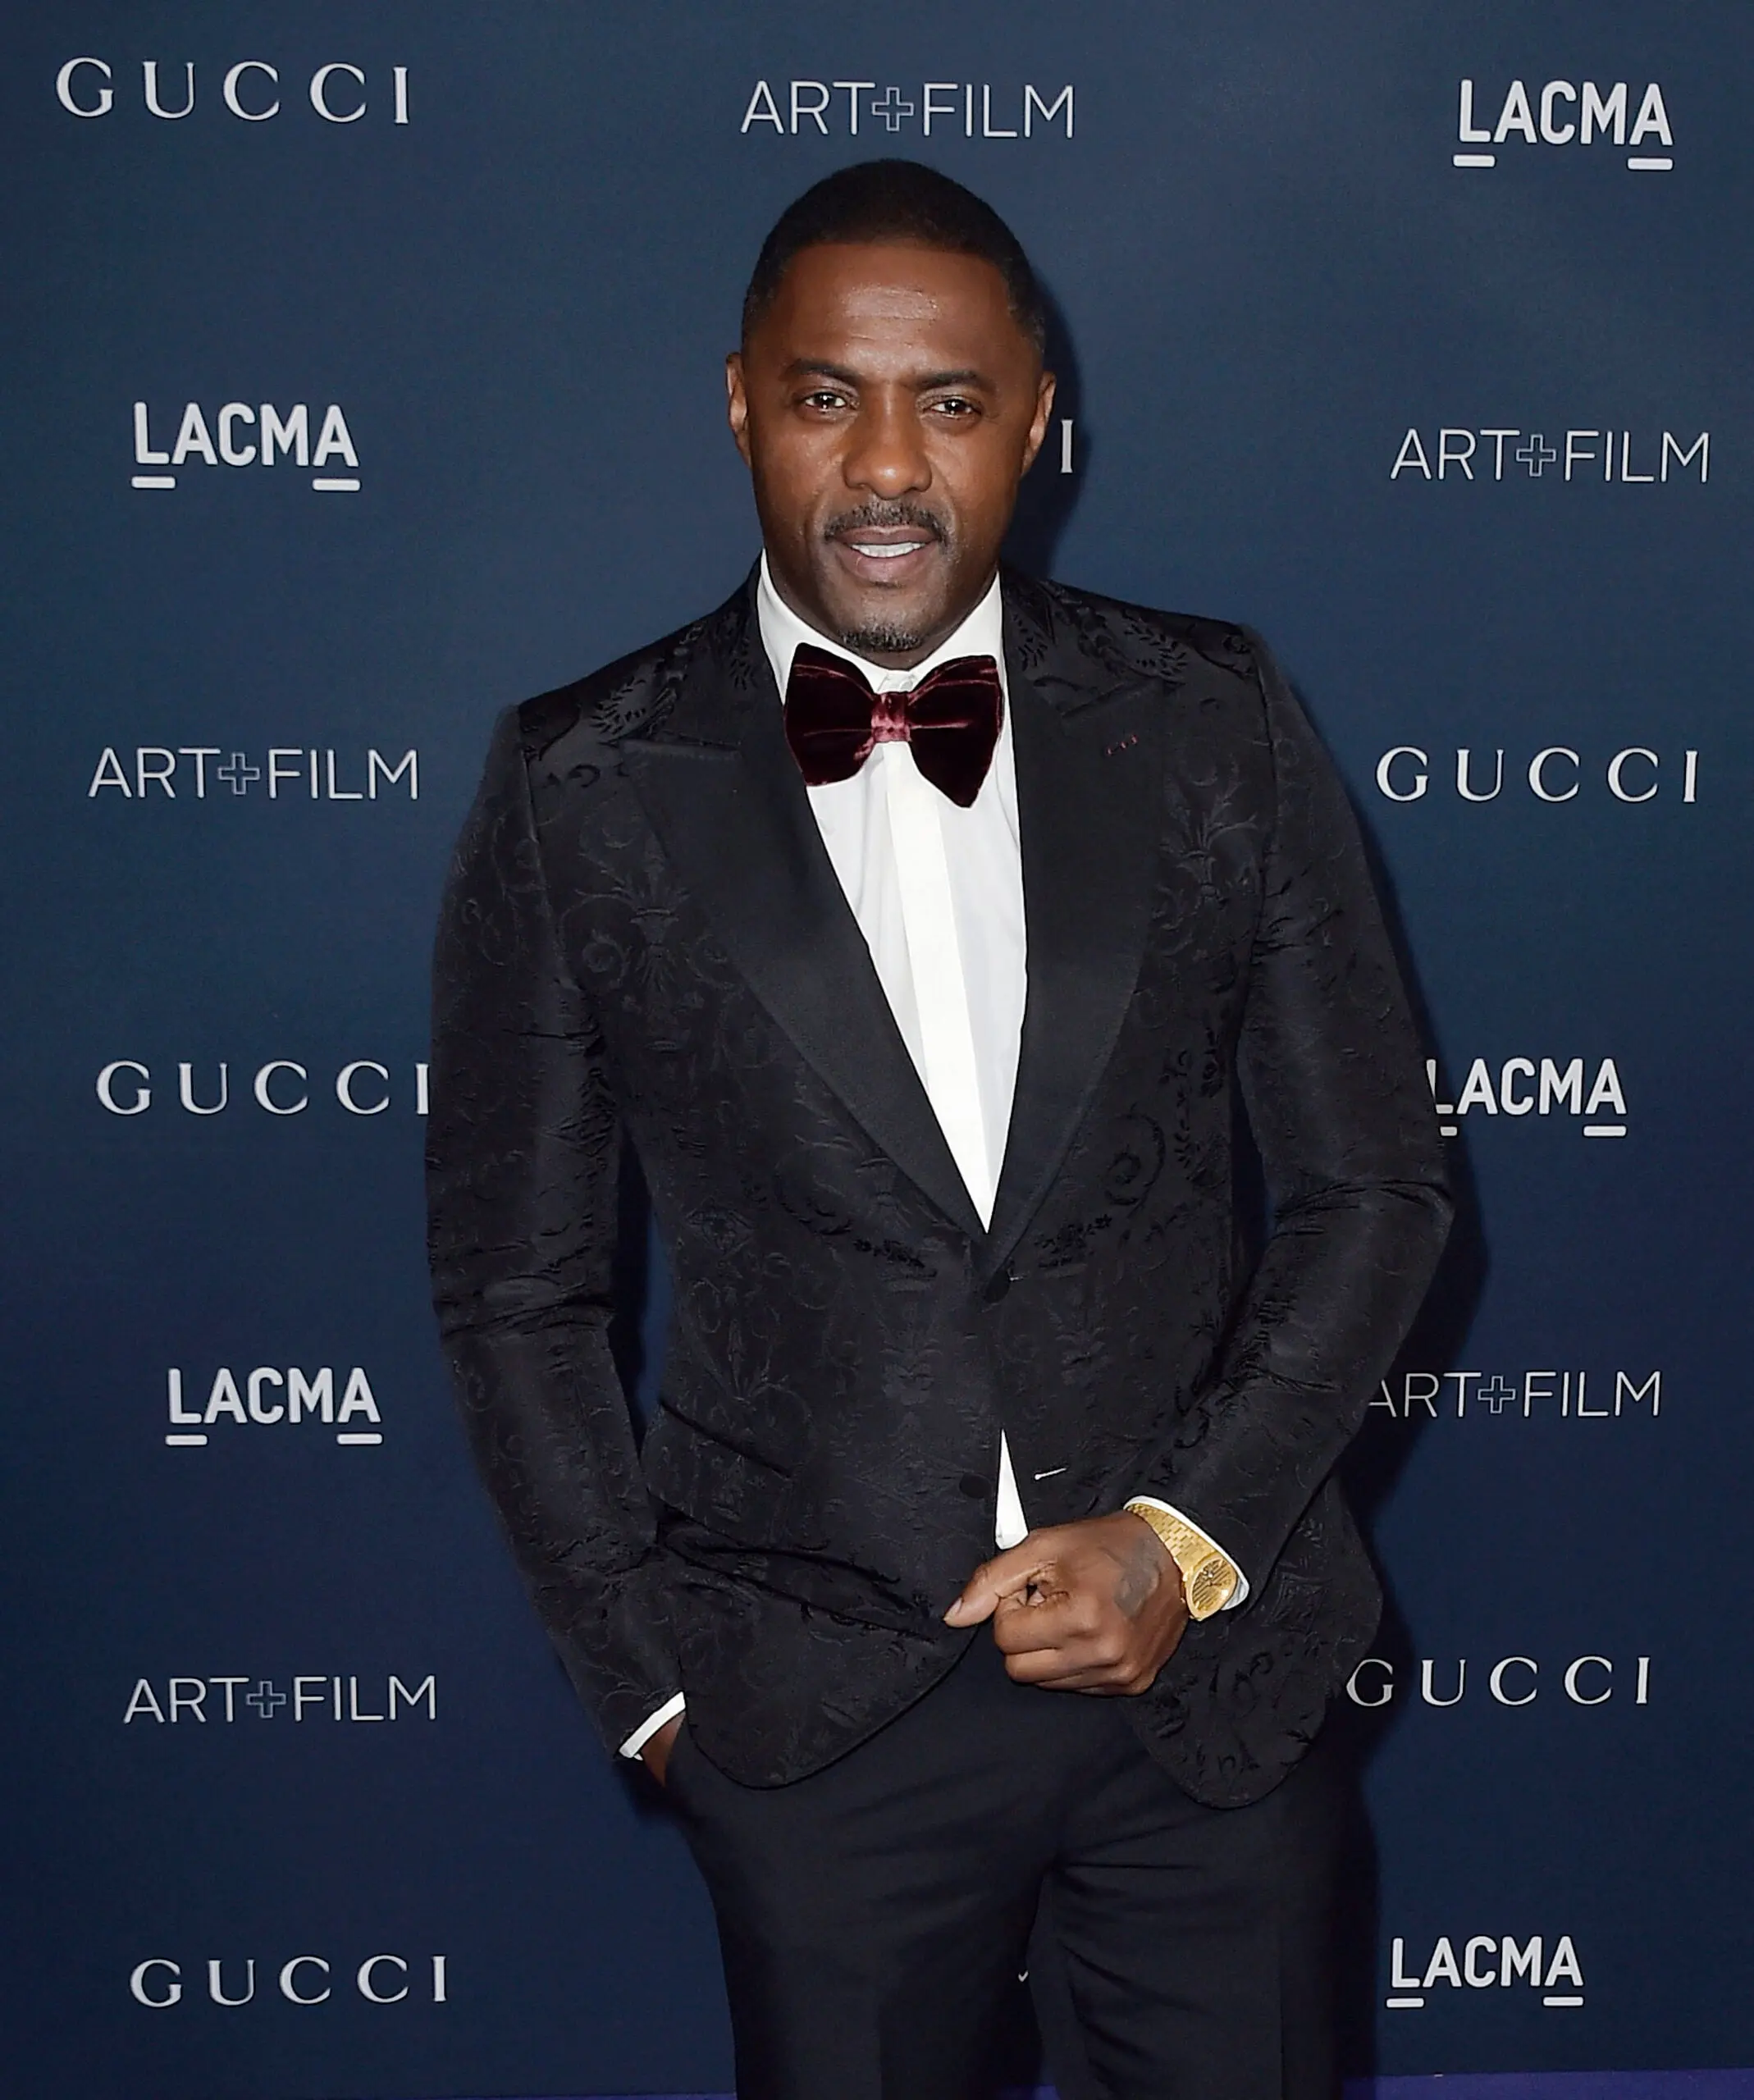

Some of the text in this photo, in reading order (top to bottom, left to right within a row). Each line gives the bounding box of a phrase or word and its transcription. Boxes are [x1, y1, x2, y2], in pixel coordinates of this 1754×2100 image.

[56, 57, 409, 124] GUCCI
[740, 80, 1073, 139] ART+FILM
[1459, 79, 1674, 146] LACMA
[134, 401, 359, 468] LACMA
[1390, 428, 1709, 483] ART+FILM
[89, 747, 418, 800] ART+FILM
[1377, 746, 1698, 802] GUCCI
[96, 1061, 429, 1115] GUCCI
[168, 1367, 381, 1424] LACMA
[124, 1675, 436, 1723] ART+FILM
[1345, 1655, 1650, 1707] GUCCI
[130, 1955, 446, 2007] GUCCI
[1391, 1935, 1584, 1988] LACMA
